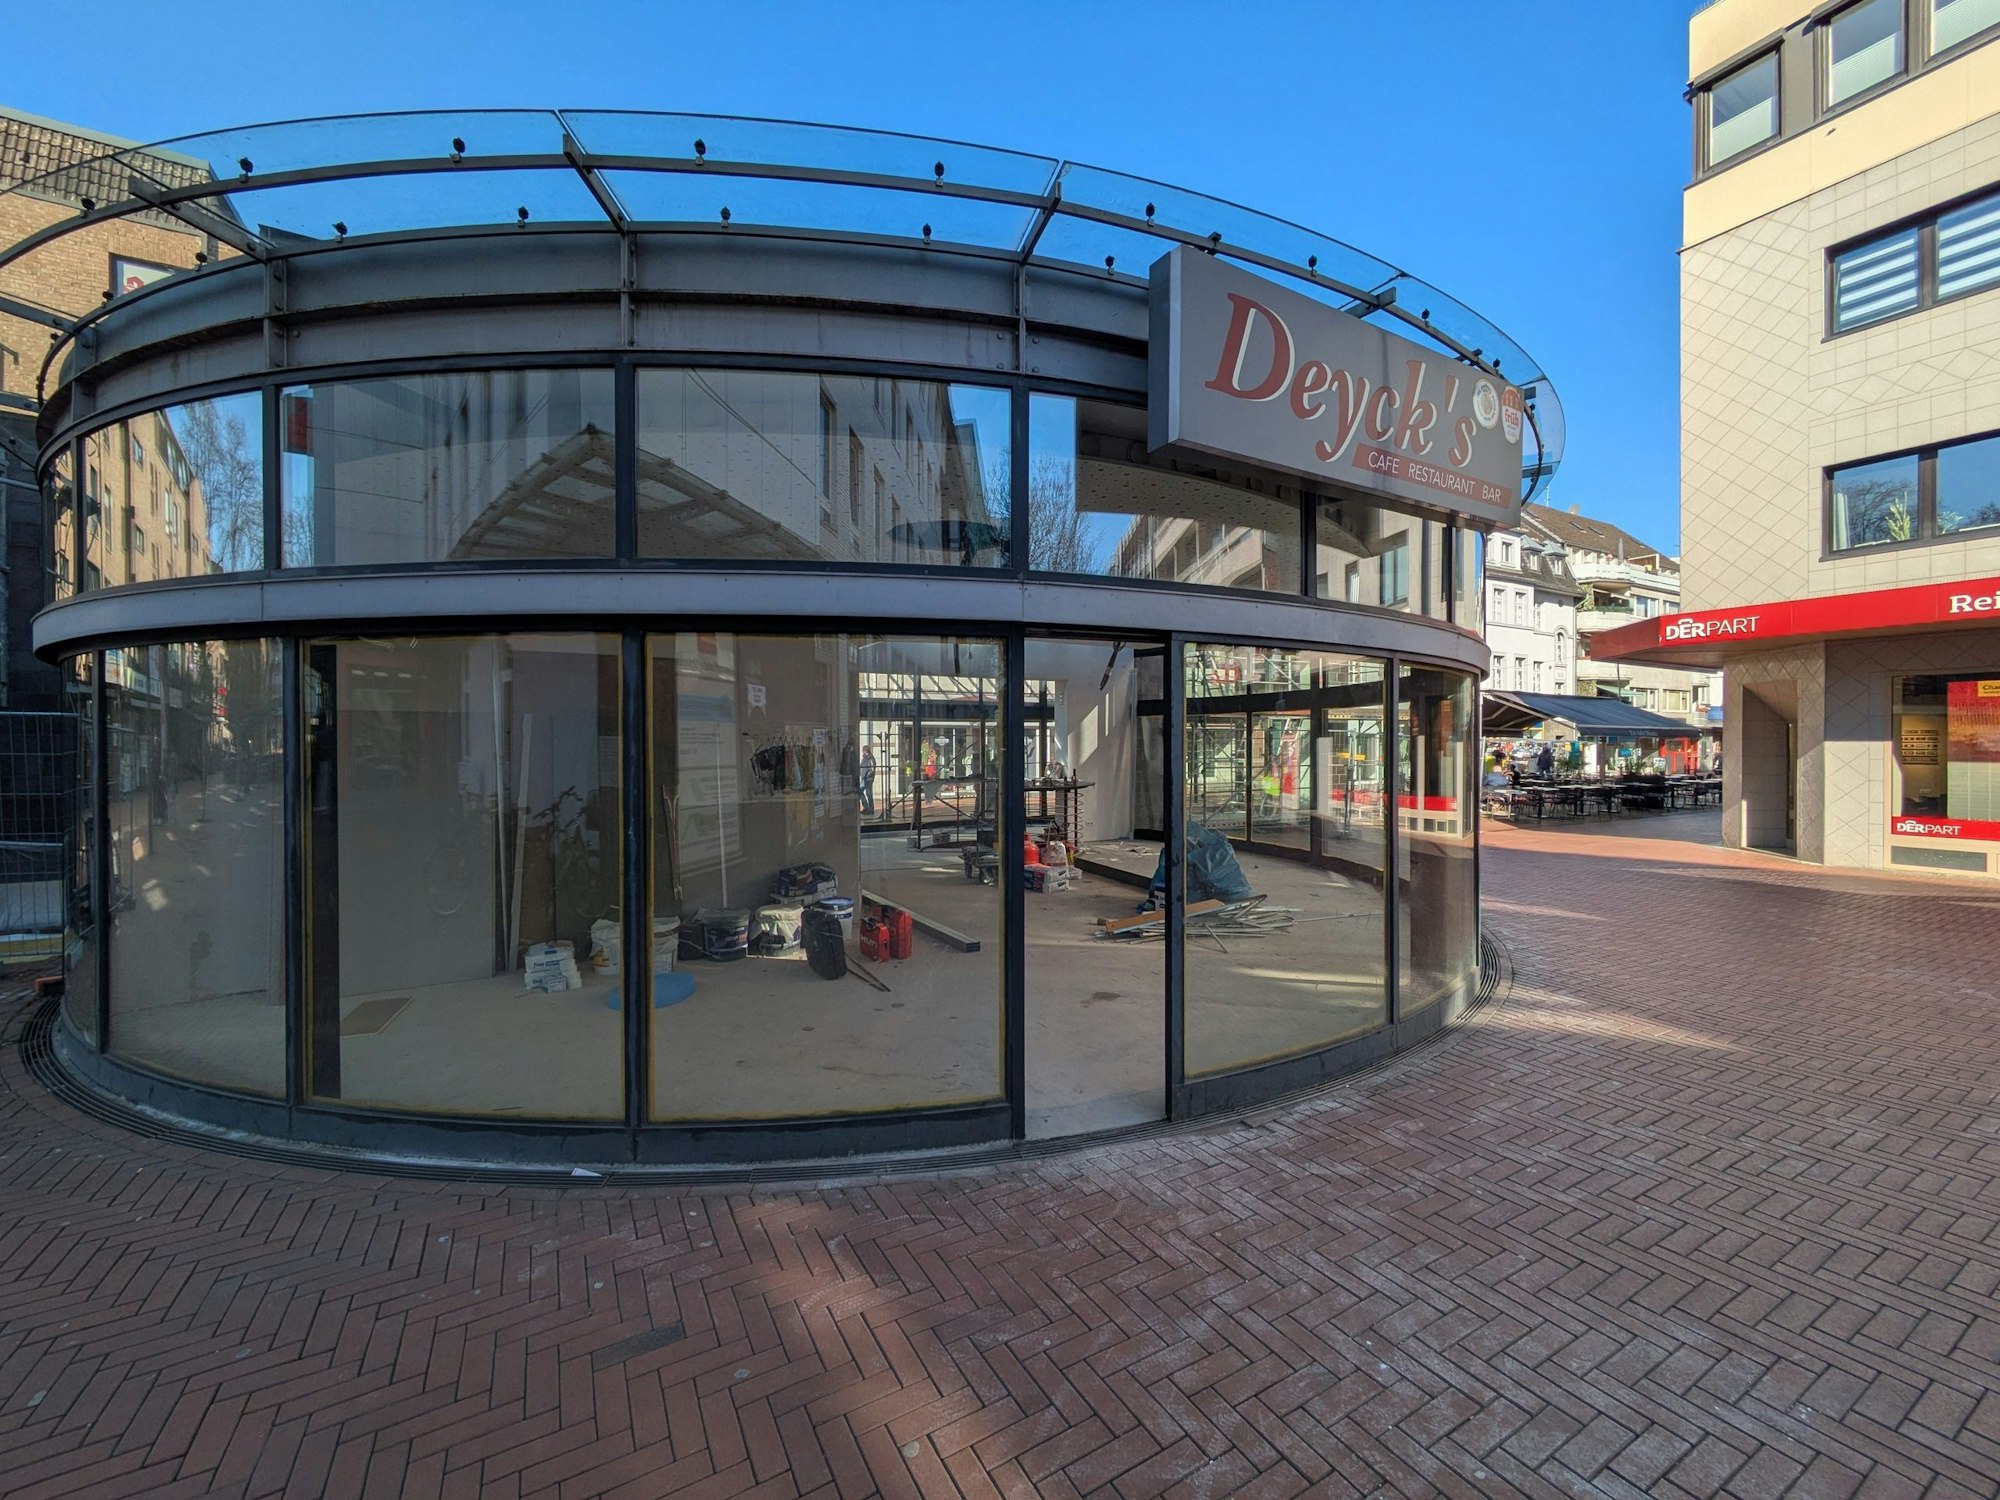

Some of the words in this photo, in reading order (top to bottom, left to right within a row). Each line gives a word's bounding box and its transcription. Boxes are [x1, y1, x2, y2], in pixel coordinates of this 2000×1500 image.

[1204, 292, 1477, 468] Deyck's
[1368, 451, 1400, 474] CAFE
[1408, 463, 1476, 495] RESTAURANT
[1482, 484, 1501, 503] BAR
[1665, 616, 1760, 640] DERPART
[1896, 820, 1962, 835] DERPART
